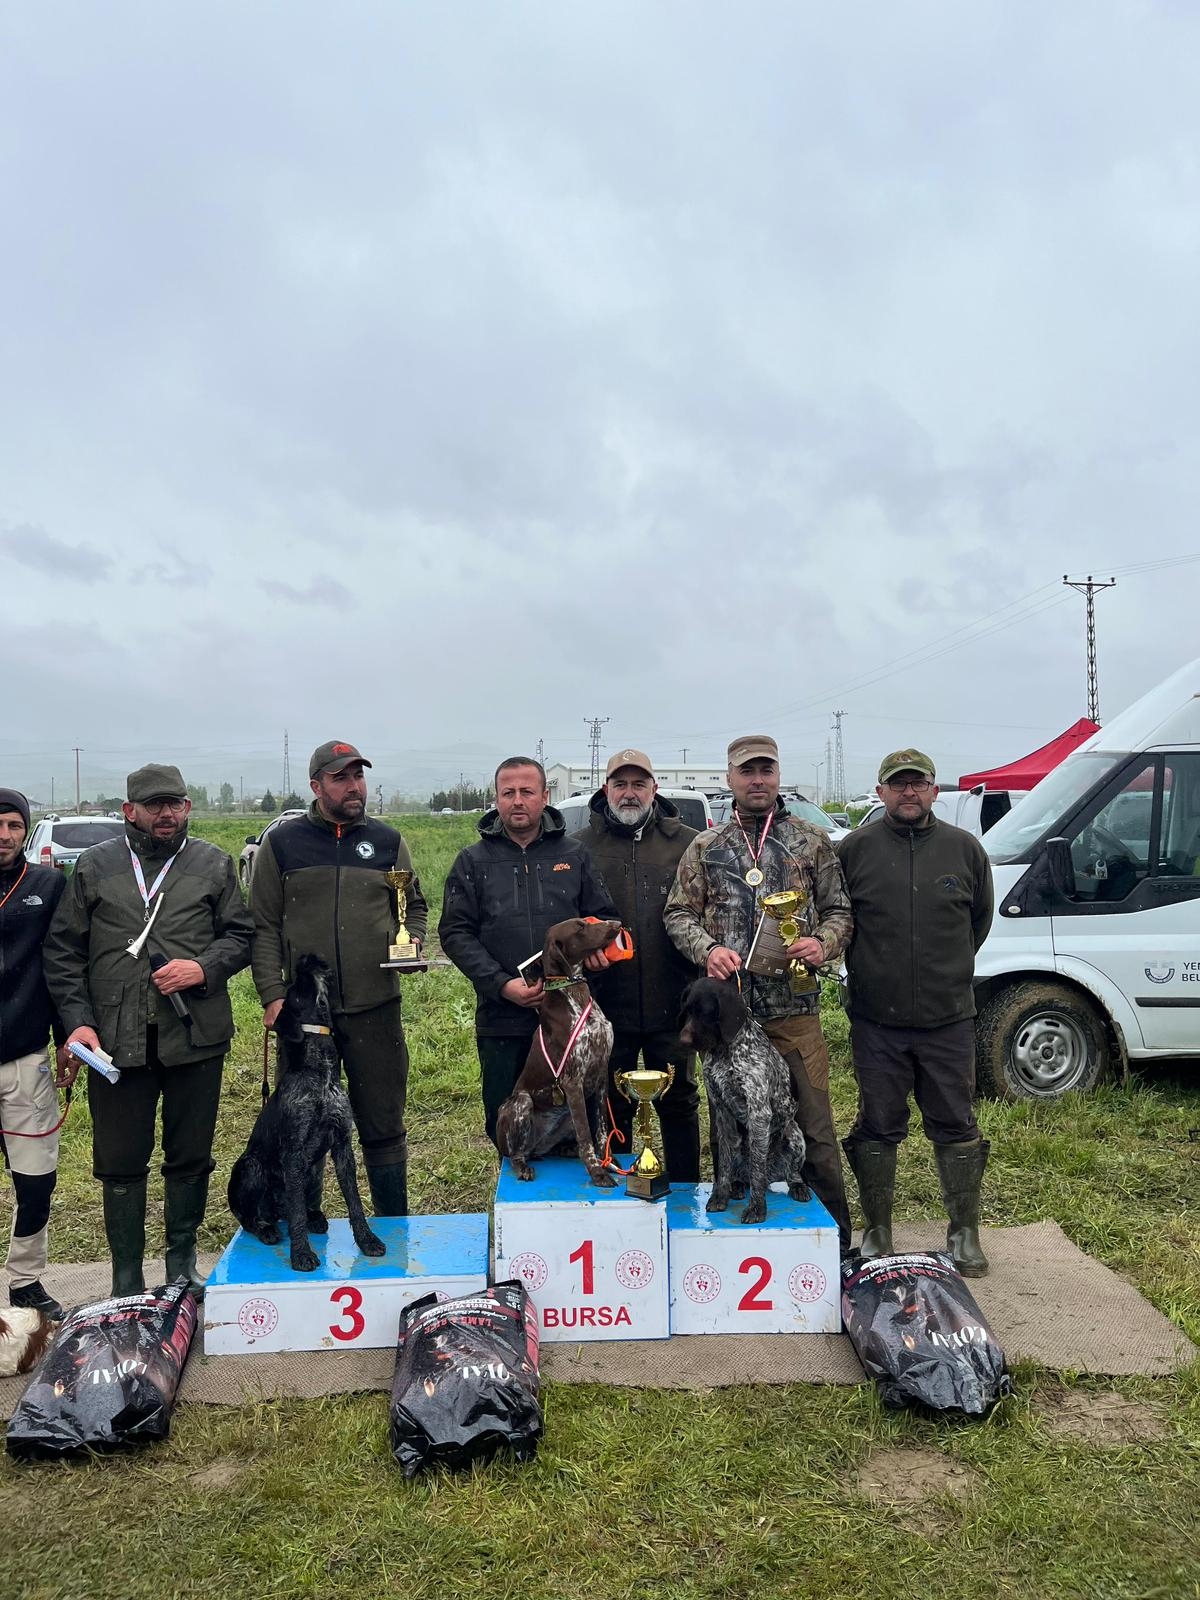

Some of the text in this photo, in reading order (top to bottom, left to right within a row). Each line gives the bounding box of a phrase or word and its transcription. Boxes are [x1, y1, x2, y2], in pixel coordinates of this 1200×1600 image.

[570, 1241, 593, 1294] 1
[875, 1270, 899, 1283] RICE
[738, 1257, 772, 1310] 2
[330, 1287, 364, 1340] 3
[460, 1316, 492, 1327] LAMB
[544, 1307, 631, 1327] BURSA
[456, 1363, 510, 1382] OYAL
